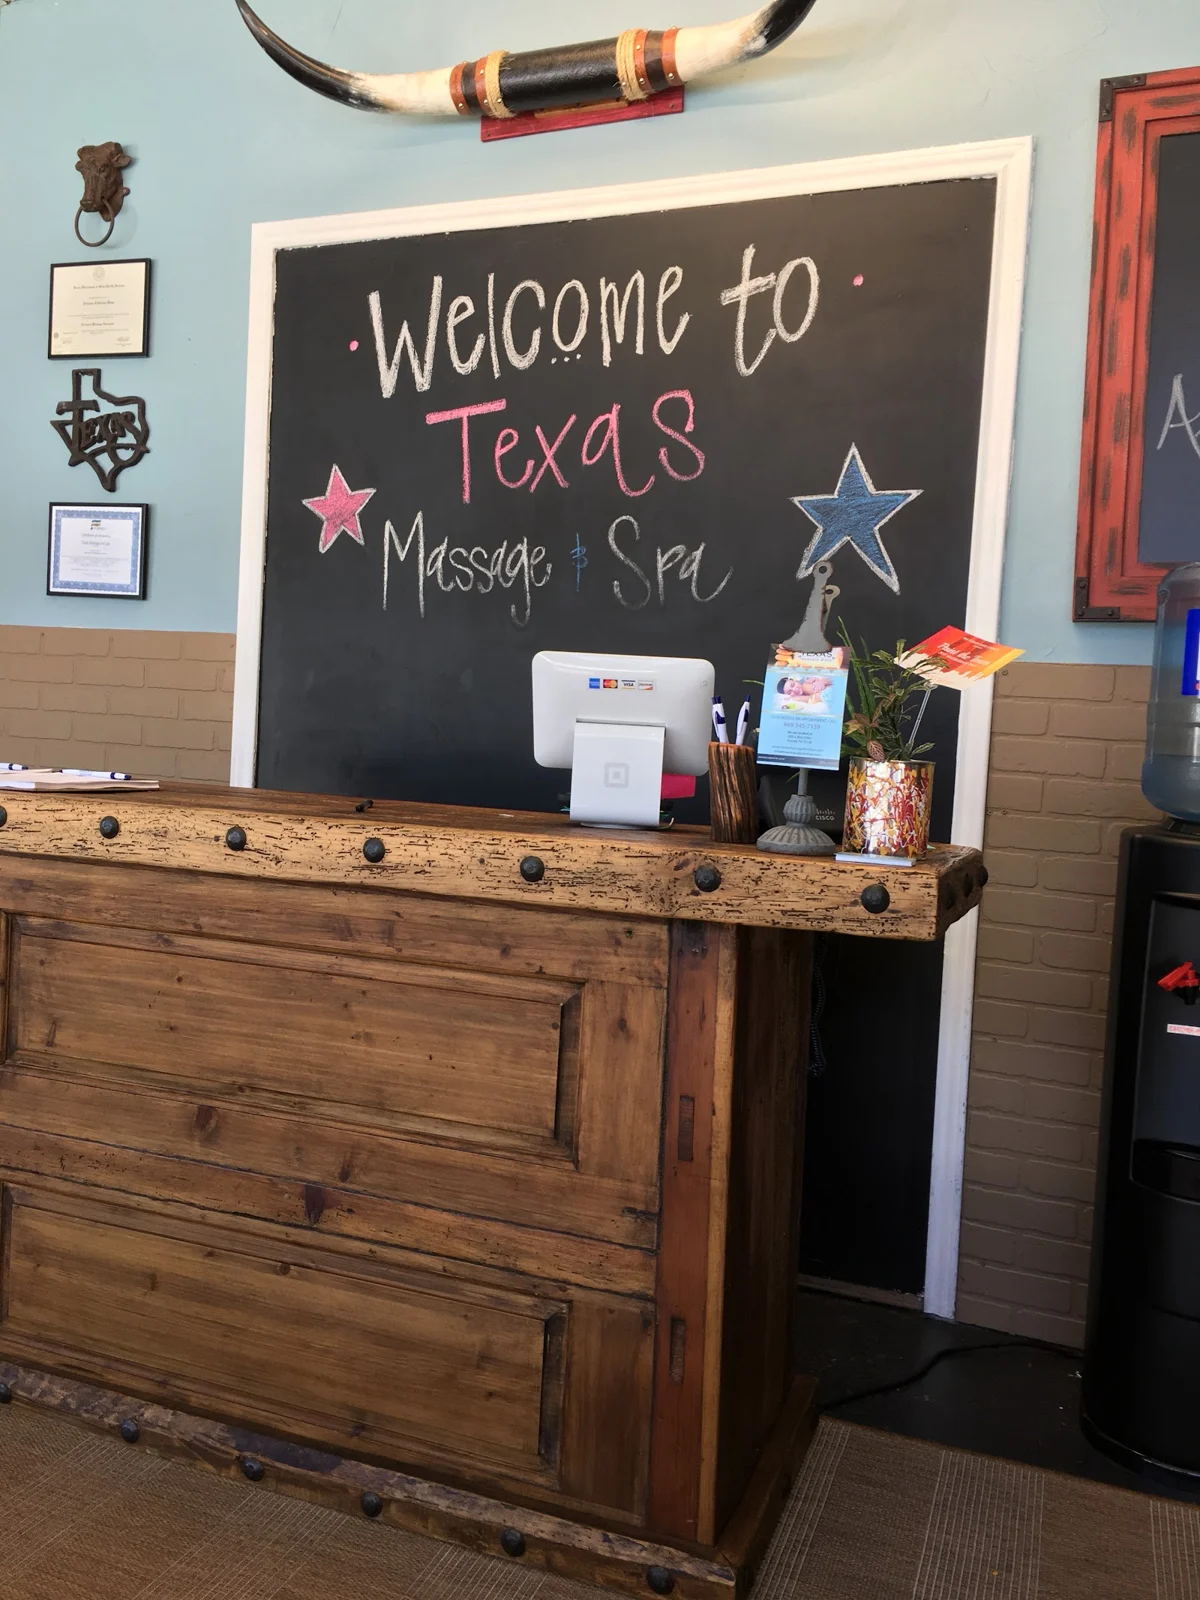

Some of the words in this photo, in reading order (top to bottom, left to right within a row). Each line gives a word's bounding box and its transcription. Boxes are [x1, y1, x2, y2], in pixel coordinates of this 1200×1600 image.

[368, 264, 693, 399] Welcome
[718, 243, 820, 377] to
[425, 389, 706, 504] Texas
[382, 510, 553, 628] Massage
[607, 514, 734, 611] Spa
